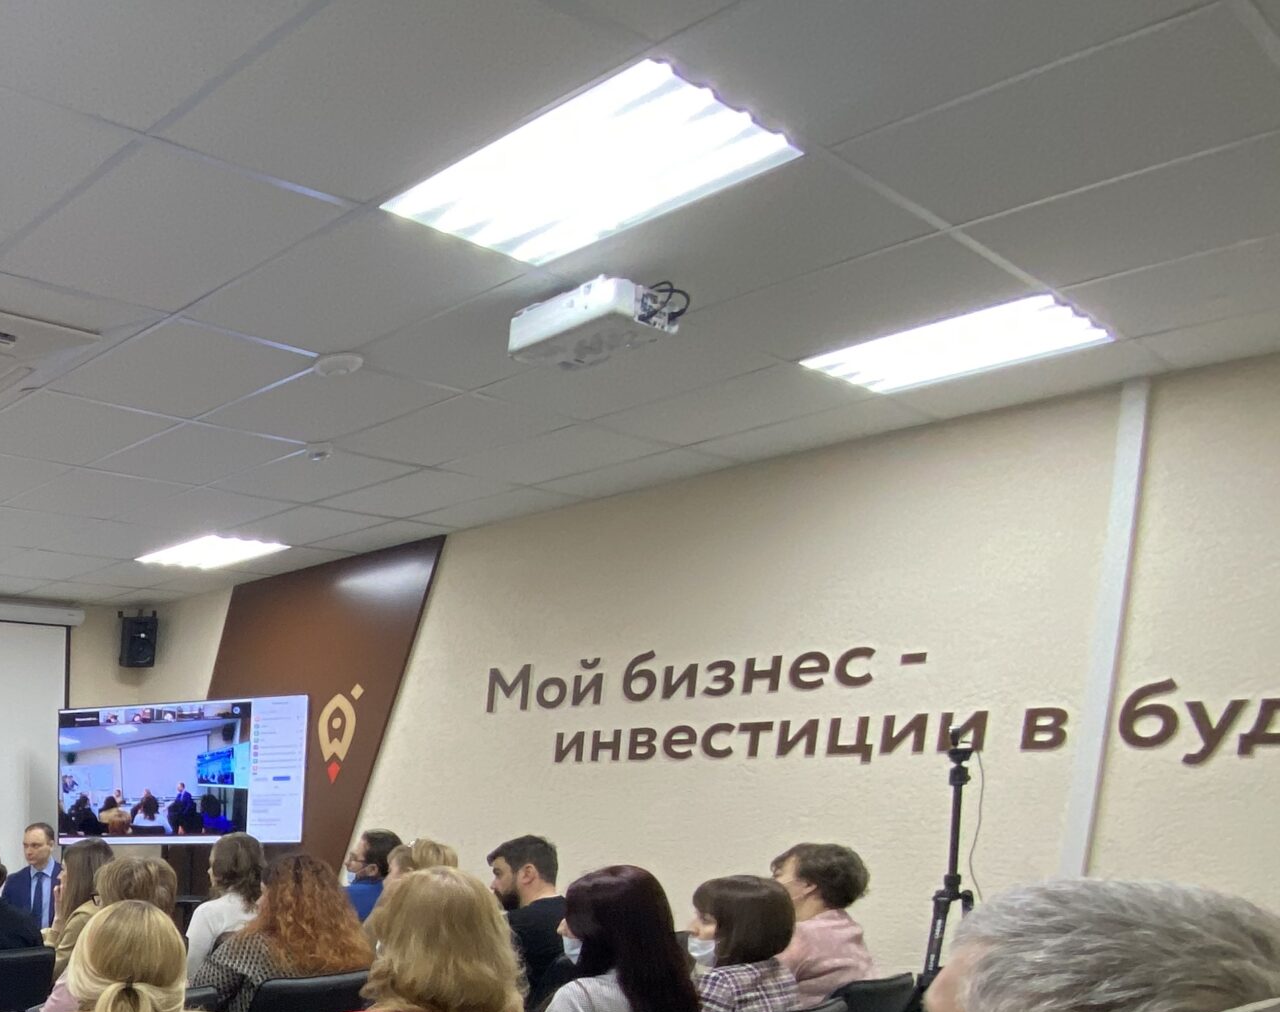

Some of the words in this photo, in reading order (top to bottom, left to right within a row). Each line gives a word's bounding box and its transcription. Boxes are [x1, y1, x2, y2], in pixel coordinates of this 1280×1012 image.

[486, 657, 604, 713] Мой
[622, 646, 876, 702] бизнес
[553, 710, 989, 765] инвестиции
[1019, 706, 1070, 752] в
